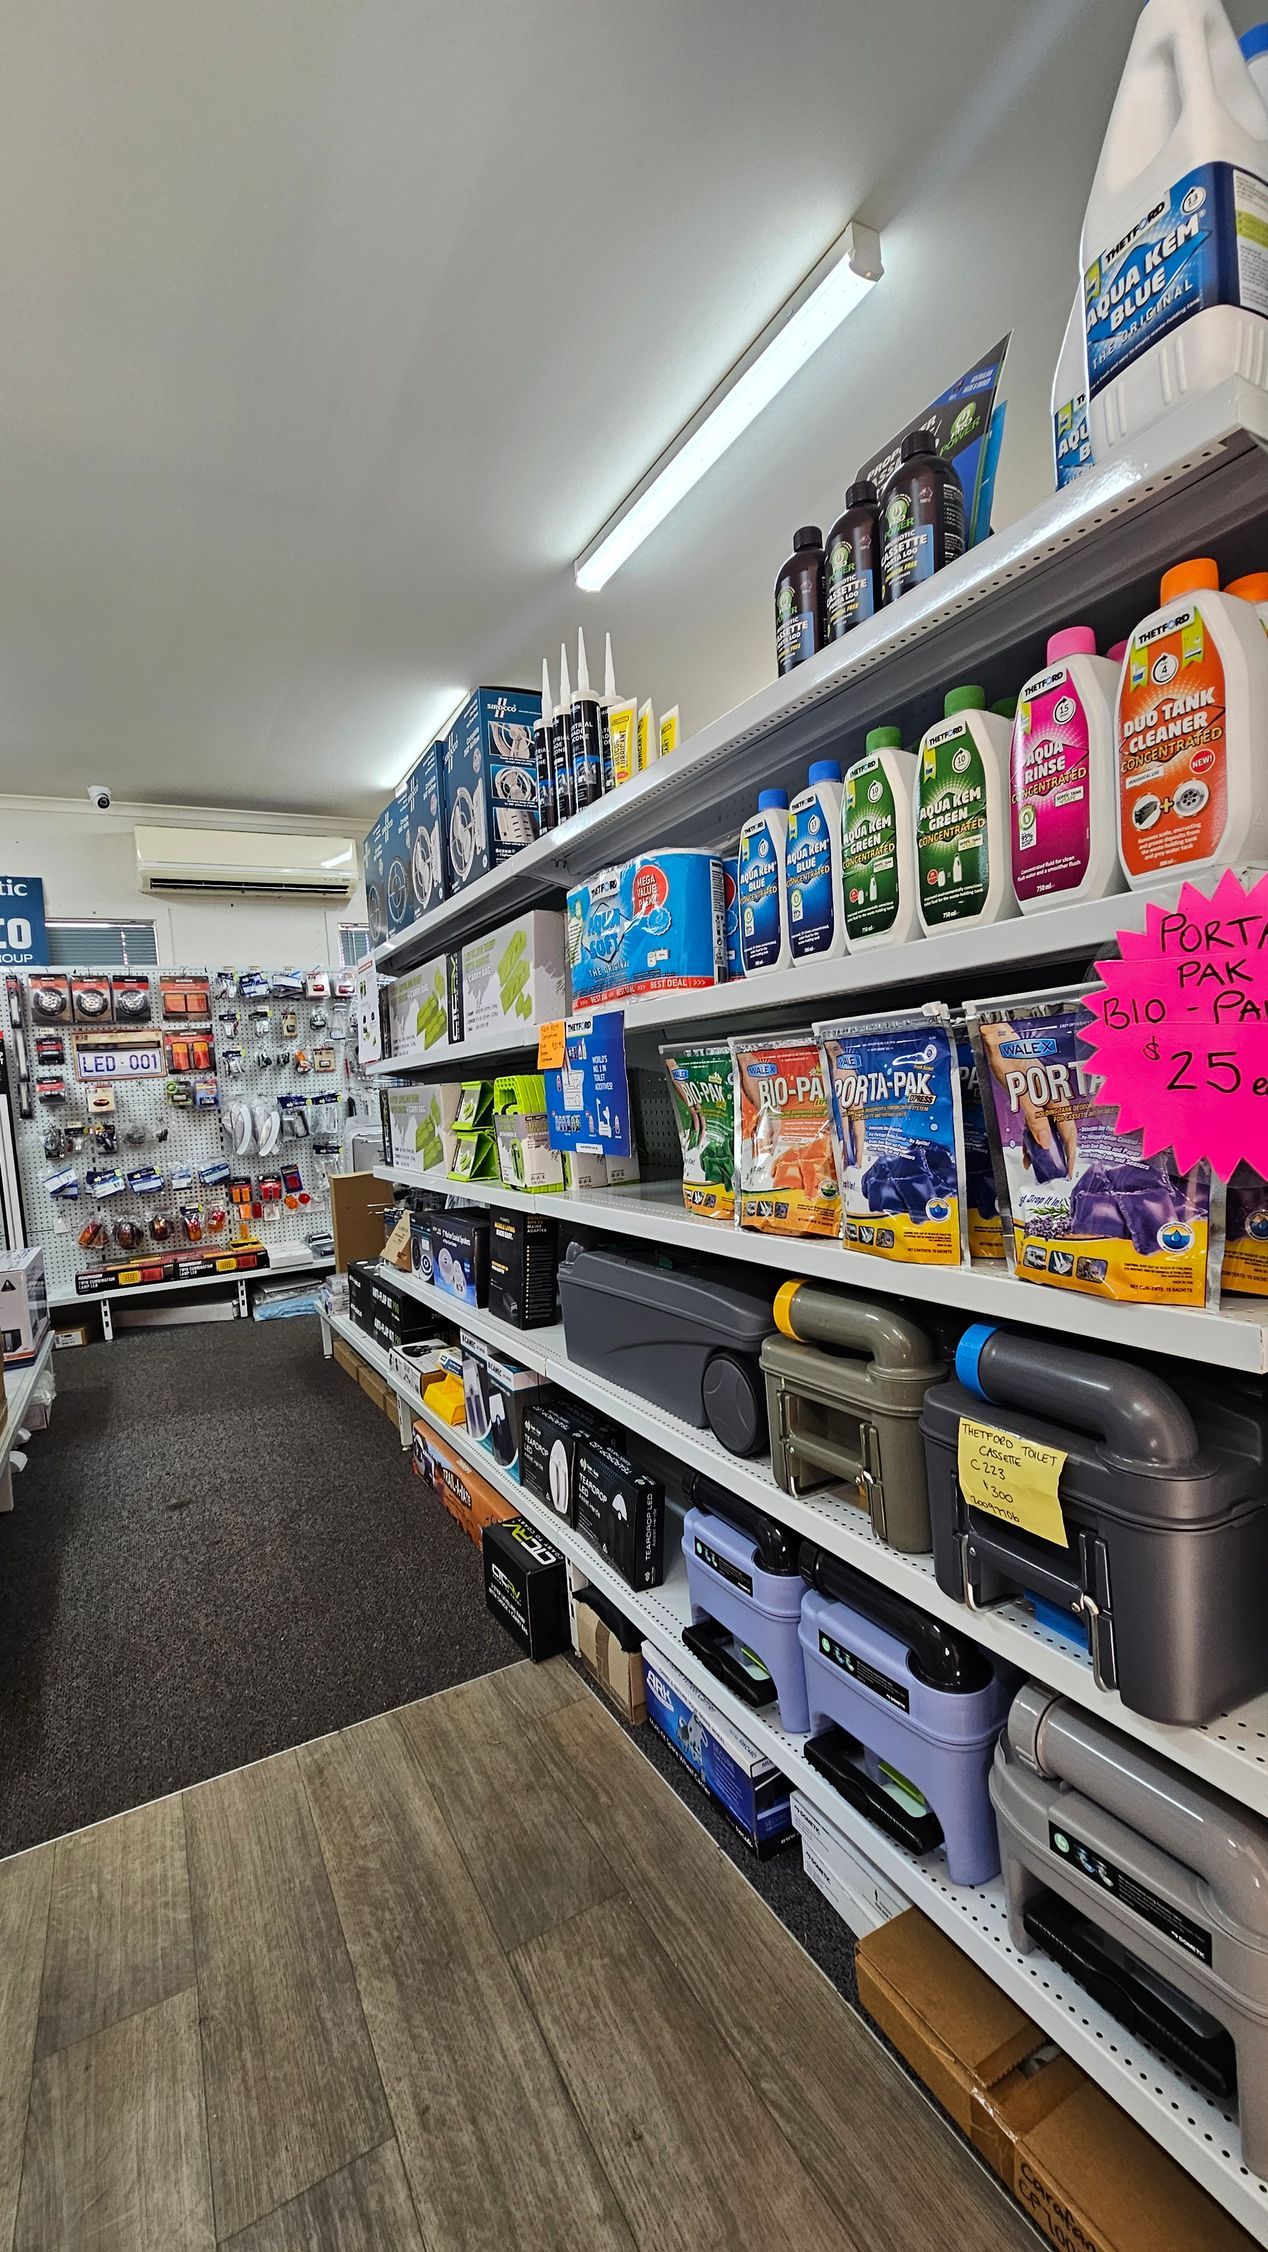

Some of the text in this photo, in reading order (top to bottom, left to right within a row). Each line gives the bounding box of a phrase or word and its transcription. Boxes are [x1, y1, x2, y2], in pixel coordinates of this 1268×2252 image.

[1105, 201, 1165, 263] THETFORD
[1087, 214, 1199, 333] AQUA KEM
[1111, 266, 1165, 331] BLUE
[1092, 342, 1115, 370] THE
[1121, 279, 1193, 343] ORIGINAL
[1139, 613, 1190, 644] THETFORD
[1024, 672, 1063, 696] THETFORD
[1124, 687, 1215, 738] DUO TANK
[929, 726, 962, 745] THETFORD
[1130, 711, 1208, 753] CLEANER
[957, 756, 966, 764] 10
[1024, 741, 1063, 766] AQUA
[1121, 727, 1223, 773] CONCENTRATED
[1192, 755, 1213, 769] NEW!
[850, 761, 876, 778] THETFORD
[1024, 755, 1065, 785] RINSE
[1012, 767, 1086, 804] CNCENTRATED
[792, 796, 814, 811] THETFORD
[920, 786, 981, 821] AQUA KEM
[744, 822, 763, 834] THETFORD
[844, 815, 892, 845] AQUA KEM
[929, 807, 968, 831] GREEN
[851, 833, 881, 854] GREEN
[918, 818, 986, 848] CONCENTRATED
[787, 840, 827, 865] AQUA KEM
[843, 843, 895, 870] CONCENTRATED
[741, 862, 775, 884] AQUA KEM
[797, 857, 816, 873] BLUE
[0, 879, 28, 896] tic
[637, 875, 656, 887] MEGA
[637, 885, 658, 897] VALUE
[749, 878, 765, 892] BLUE
[589, 934, 619, 959] SOFT
[589, 962, 629, 977] THE ORIGINAL
[1177, 959, 1254, 988] PAK
[650, 977, 688, 989] BEST DEAL
[1104, 997, 1166, 1030] BIO
[567, 1020, 592, 1032] THETFORD
[1002, 1042, 1053, 1055] WALEX
[83, 1056, 116, 1073] LED
[129, 1054, 157, 1070] 001
[750, 1066, 776, 1075] WALEX
[683, 1082, 725, 1106] BIO-PAK
[759, 1076, 826, 1108] BIO-PA
[835, 1072, 932, 1109] PORTA-PAK
[1126, 1159, 1150, 1171] Sensors
[1027, 1194, 1043, 1205] Drop
[524, 1442, 532, 1455] LED
[525, 1434, 549, 1457] TEARDROP
[962, 1424, 1013, 1449] THETFORD
[979, 1445, 1021, 1467] CASSETTE
[1021, 1446, 1058, 1466] TOILET
[579, 1472, 608, 1503] TEARDROP
[579, 1483, 588, 1498] LED
[645, 1514, 653, 1562] TEARDROP
[647, 1670, 673, 1705] ARK
